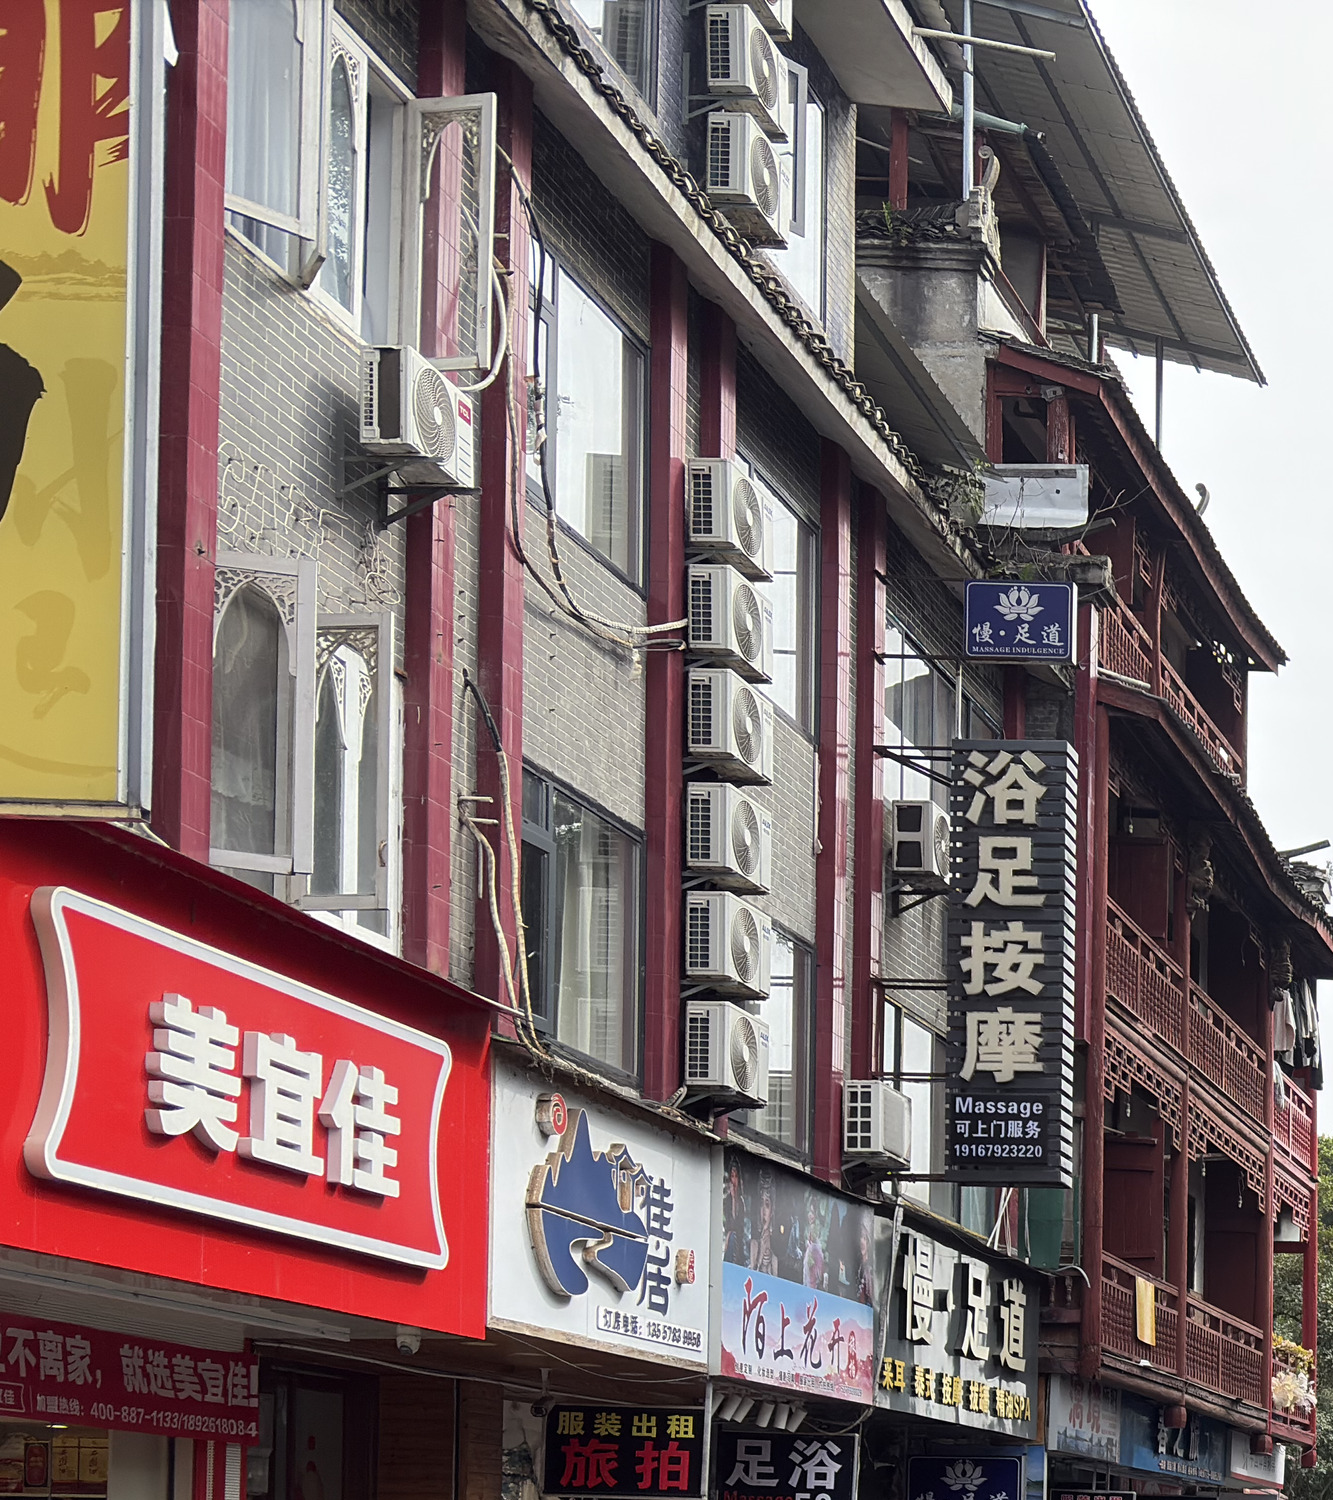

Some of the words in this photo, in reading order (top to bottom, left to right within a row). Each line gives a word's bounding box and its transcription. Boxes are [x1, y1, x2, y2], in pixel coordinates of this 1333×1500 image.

[972, 621, 1064, 646] 慢·足道
[1012, 646, 1064, 654] INDULGENCE
[958, 749, 1047, 1083] 浴足按摩
[145, 992, 401, 1198] 美宜佳
[954, 1096, 1043, 1117] Massage
[954, 1119, 1042, 1140] 可上门服务
[953, 1143, 1043, 1159] 19167923220
[646, 1321, 661, 1339] 135
[742, 1276, 845, 1374] 陌上花开
[883, 1357, 906, 1393] 采耳
[914, 1365, 935, 1401] 泰式
[942, 1372, 963, 1408] 按摩
[970, 1380, 990, 1414] 拔罐
[996, 1387, 1031, 1421] 精油SPA
[557, 1411, 695, 1439] 服装出租
[560, 1438, 690, 1491] 旅拍
[725, 1438, 843, 1490] 足浴
